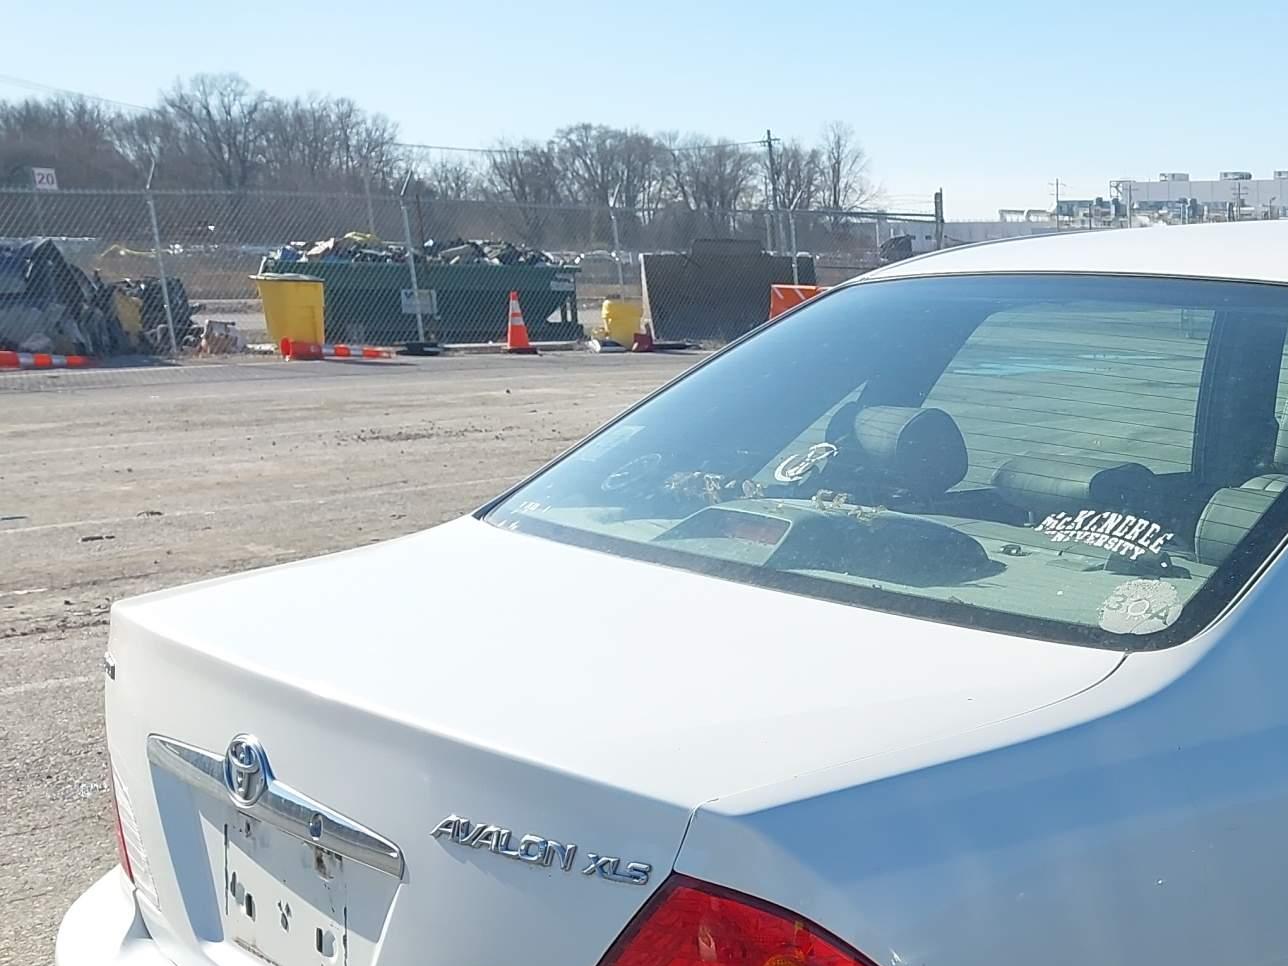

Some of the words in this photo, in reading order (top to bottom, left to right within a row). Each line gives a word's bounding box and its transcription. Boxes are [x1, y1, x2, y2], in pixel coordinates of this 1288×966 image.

[37, 173, 55, 186] 20
[429, 814, 578, 872] AVALON
[581, 853, 653, 885] XLS
